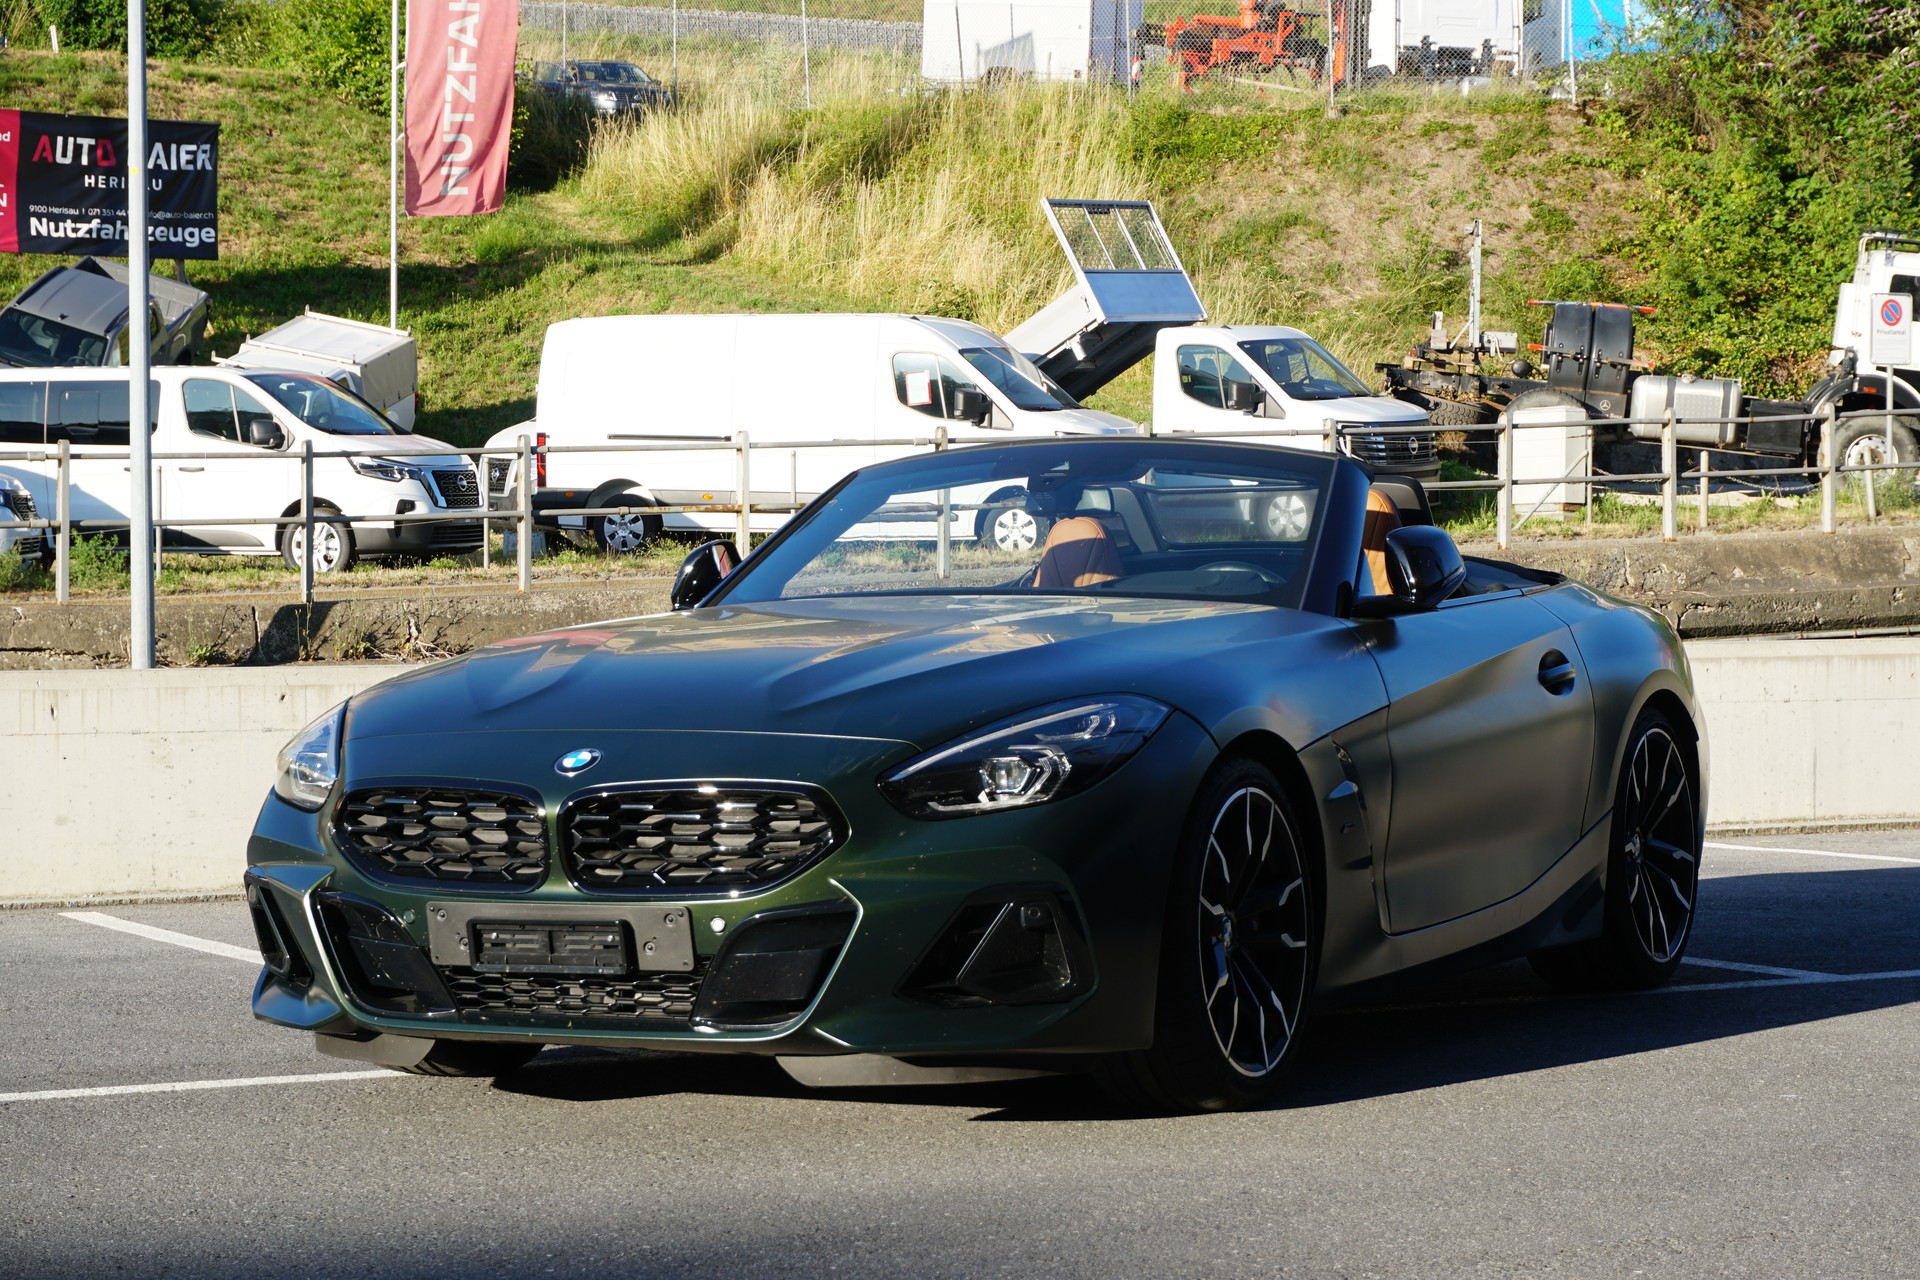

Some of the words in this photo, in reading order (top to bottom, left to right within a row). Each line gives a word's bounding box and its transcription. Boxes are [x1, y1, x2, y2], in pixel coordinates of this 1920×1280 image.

[32, 134, 117, 167] AUTO
[128, 141, 213, 171] AIER
[84, 174, 163, 191] HERIU
[29, 205, 47, 213] 9100
[48, 206, 79, 215] Herisau
[88, 208, 100, 216] 071
[101, 208, 115, 217] 351
[29, 217, 216, 248] Nutzfahzeuge
